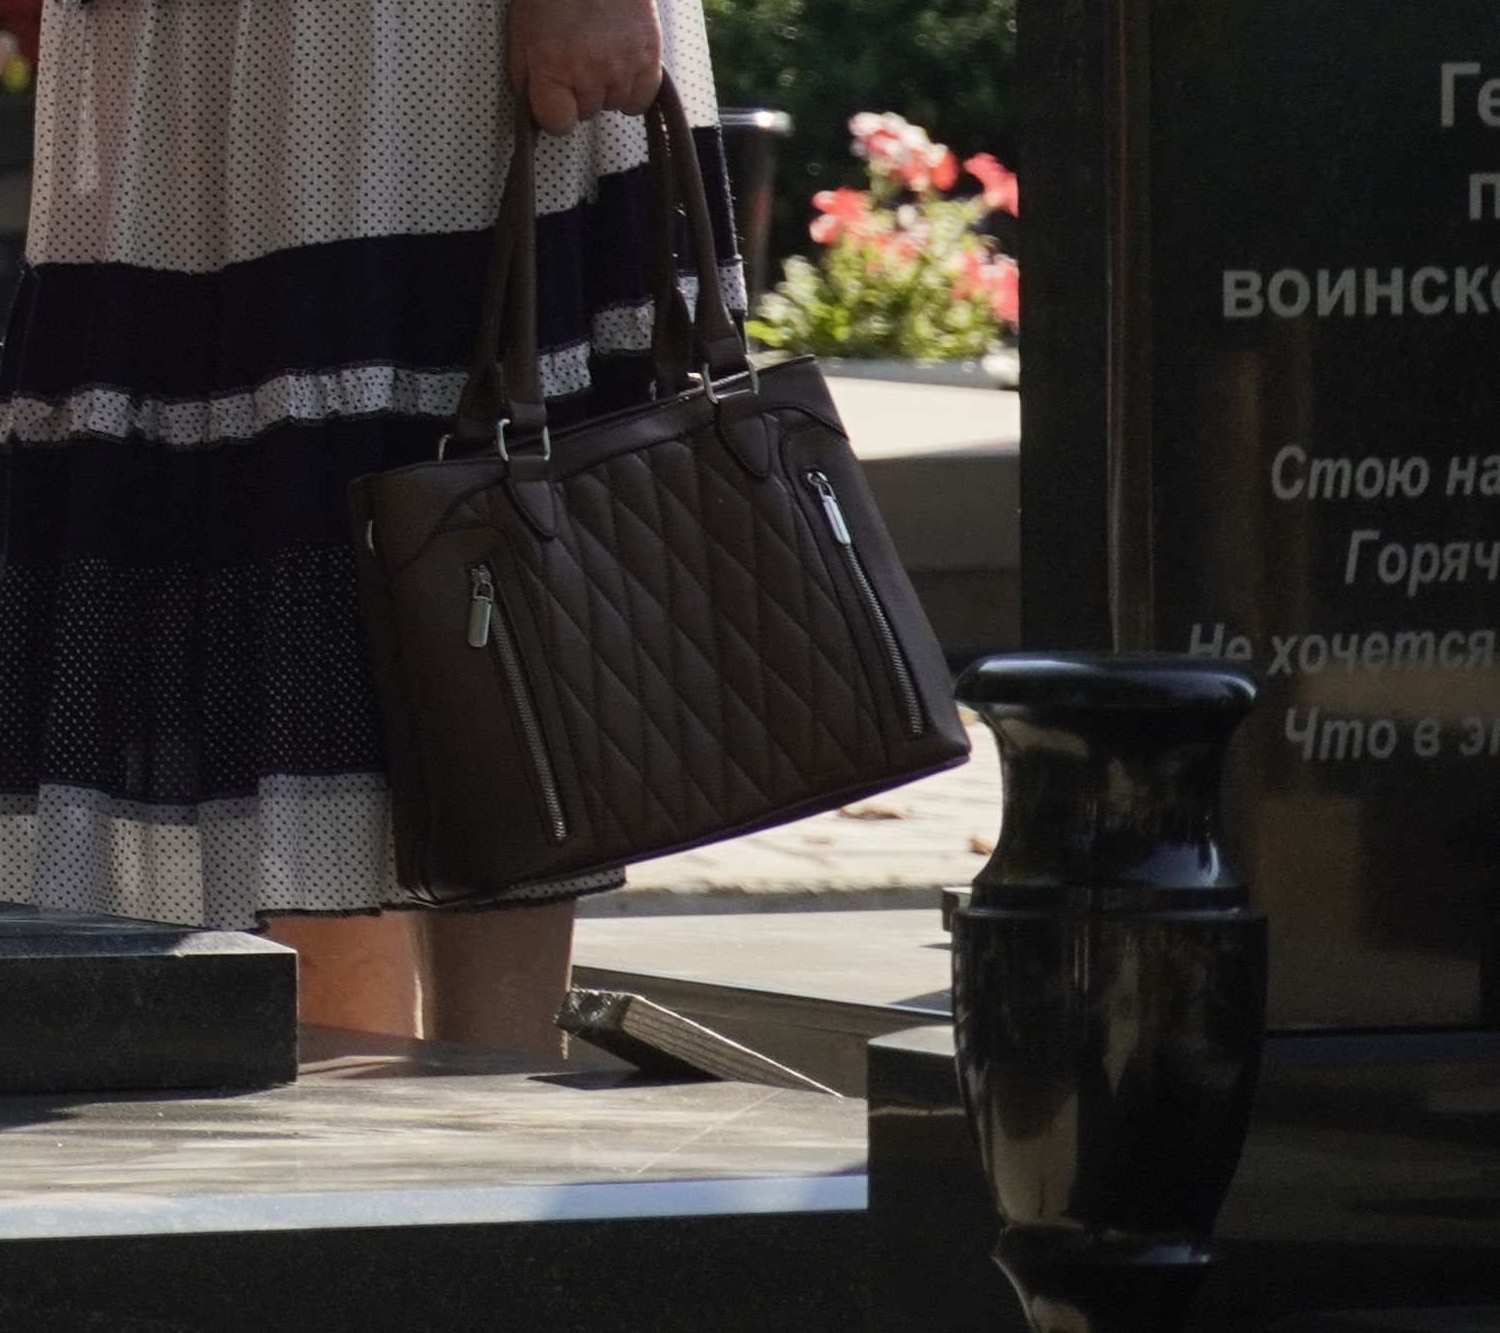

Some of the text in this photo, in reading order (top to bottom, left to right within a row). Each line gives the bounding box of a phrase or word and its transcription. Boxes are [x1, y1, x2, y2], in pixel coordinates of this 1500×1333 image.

[1222, 264, 1500, 319] воинск
[1271, 444, 1430, 501] Стою
[1345, 529, 1500, 599] Горяч
[1267, 629, 1497, 675] хочется
[1284, 705, 1397, 761] Что
[1414, 716, 1441, 758] в
